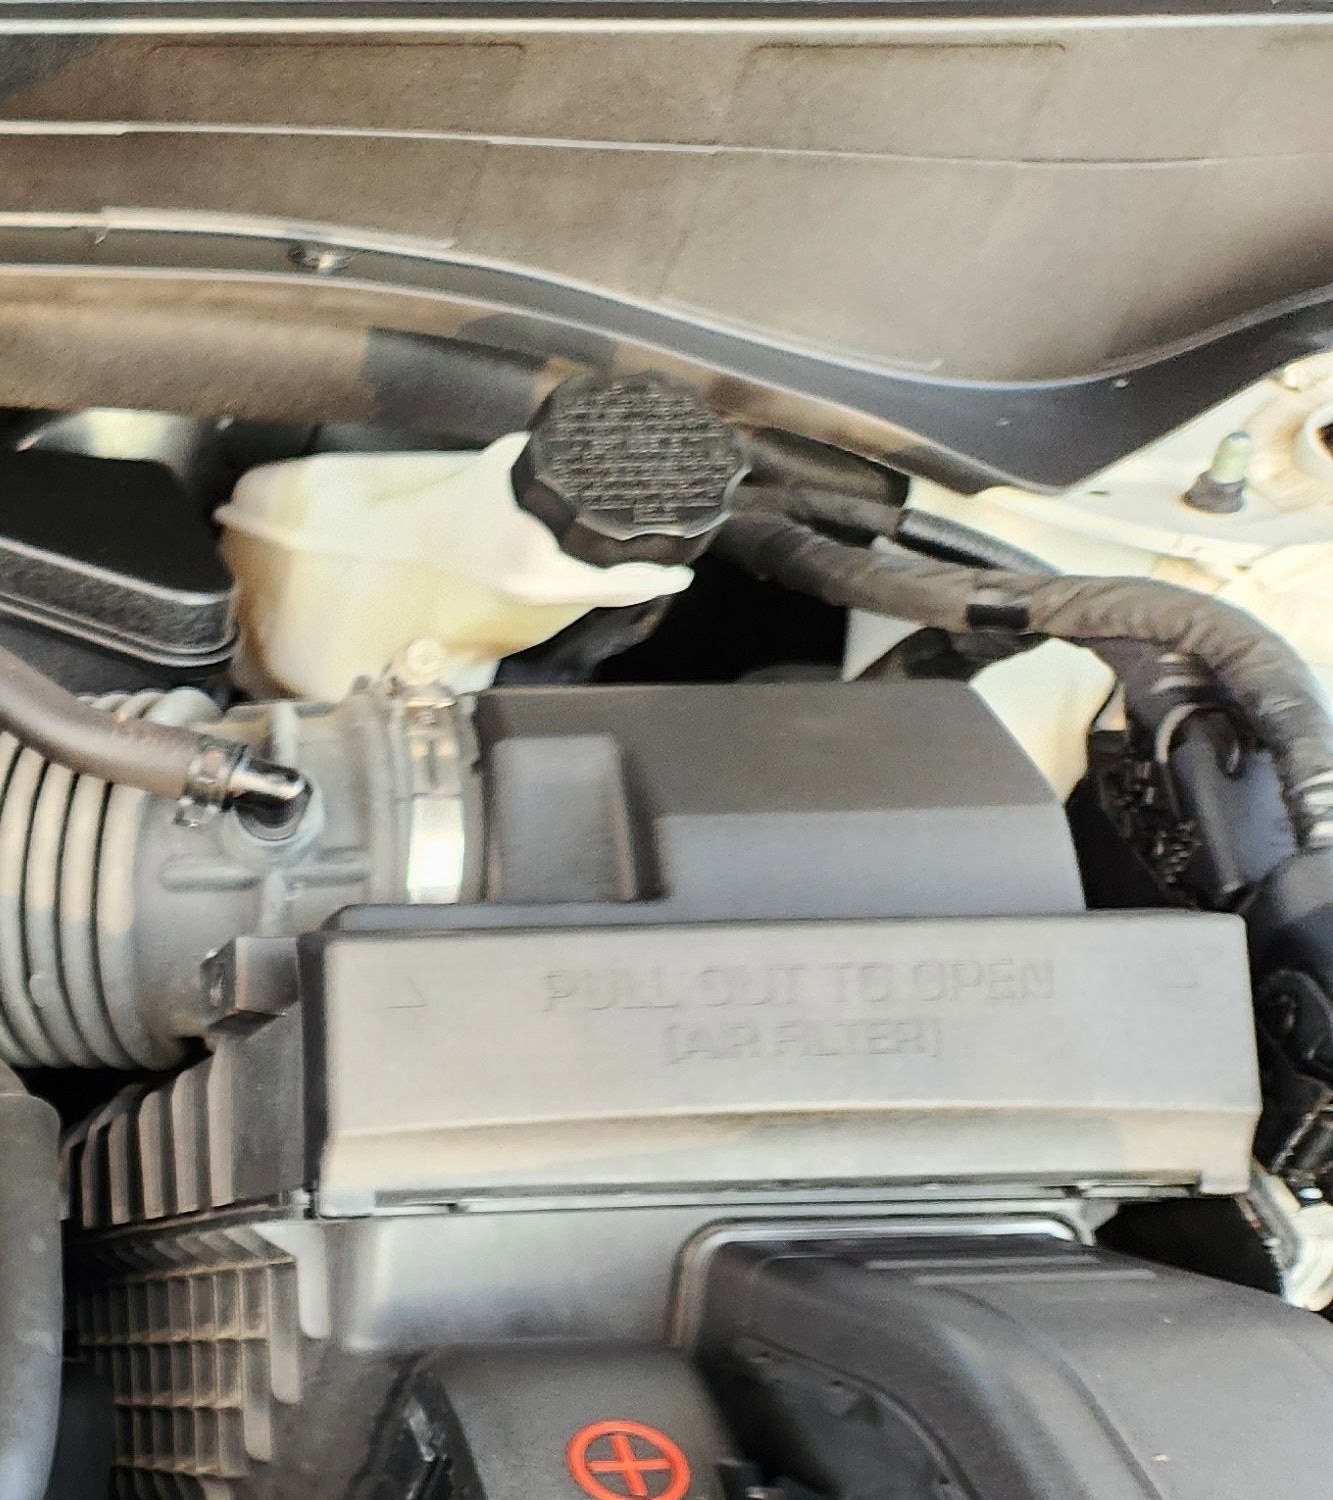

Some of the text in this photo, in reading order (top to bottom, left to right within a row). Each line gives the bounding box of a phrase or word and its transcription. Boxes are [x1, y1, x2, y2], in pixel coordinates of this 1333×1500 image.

[541, 957, 1056, 1013] PULL OUT TO OPEN
